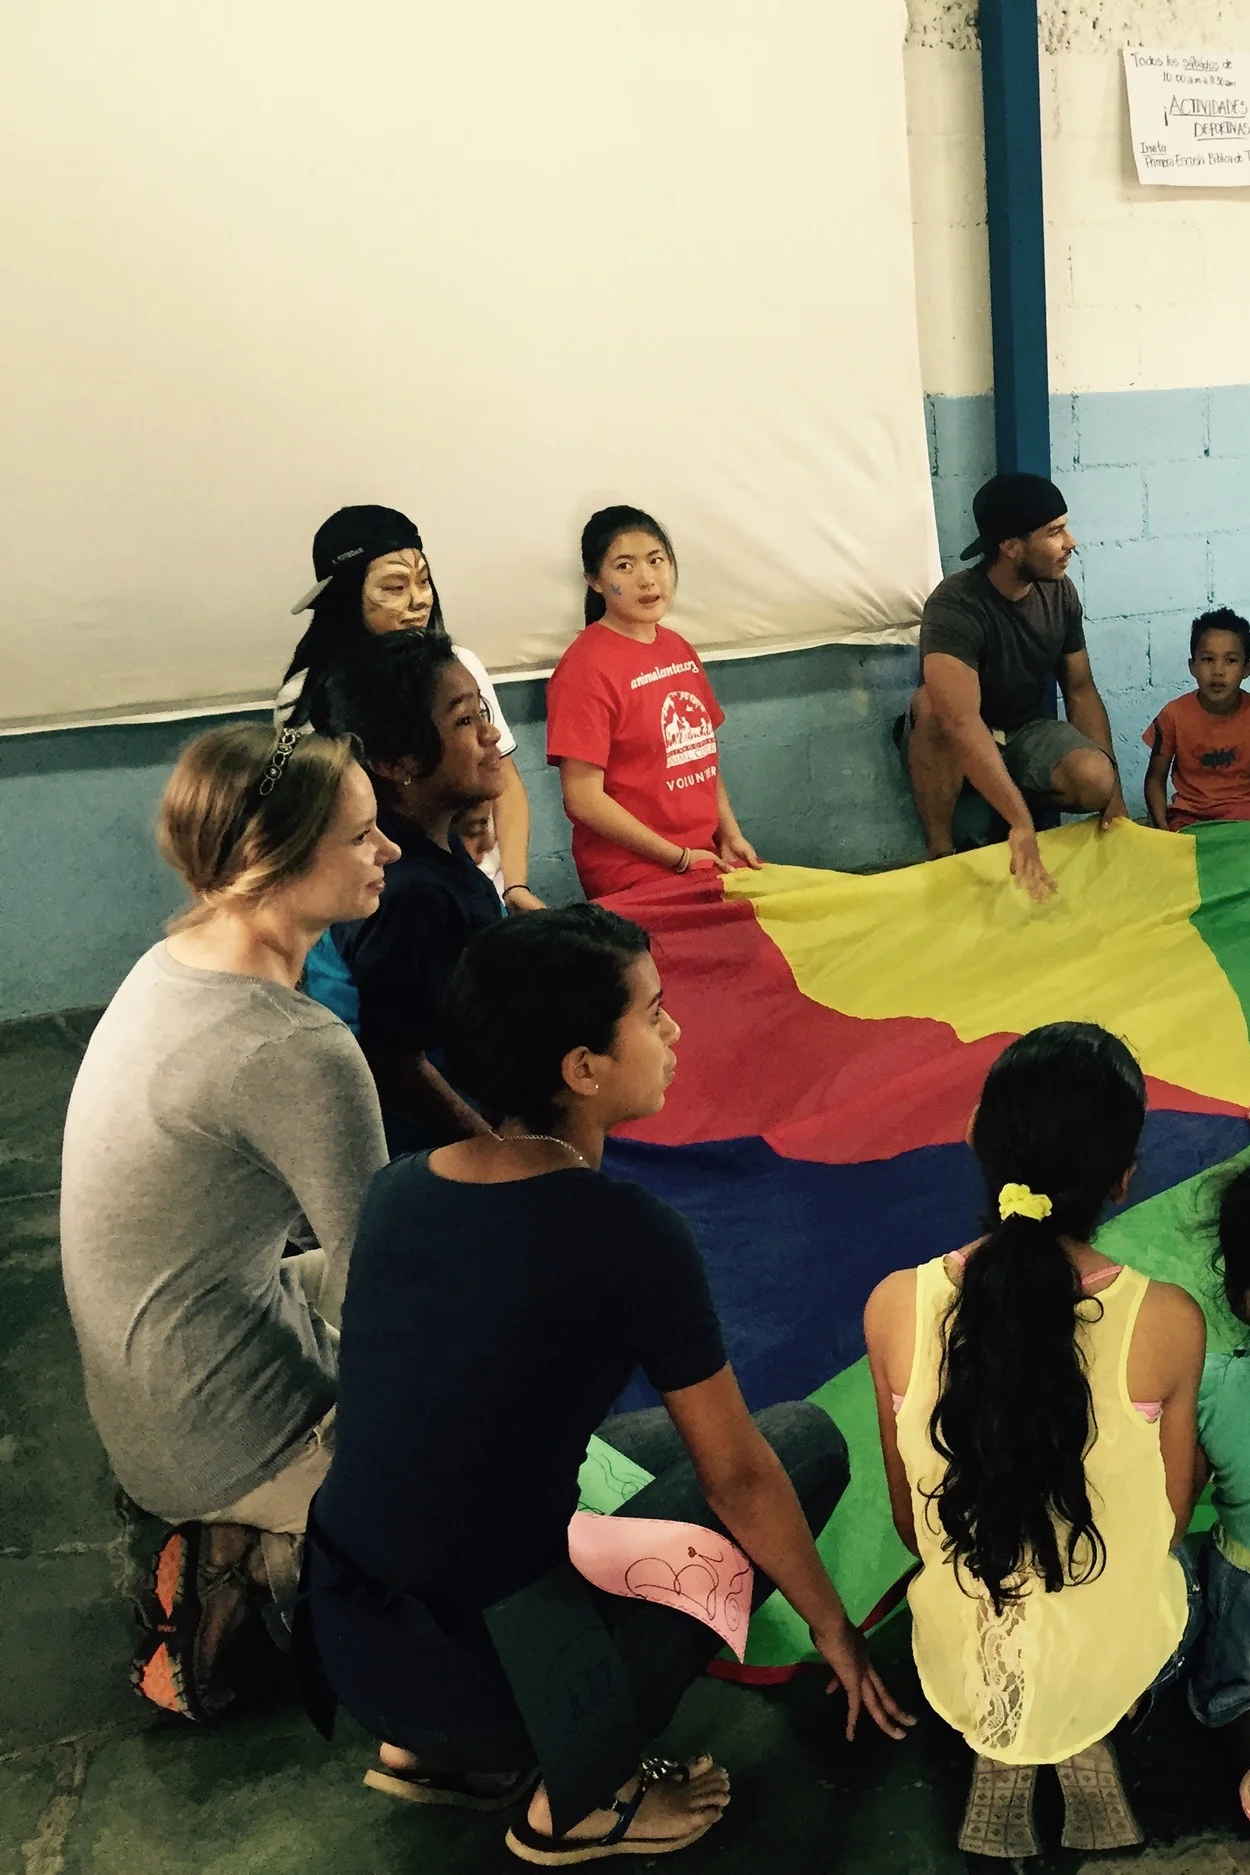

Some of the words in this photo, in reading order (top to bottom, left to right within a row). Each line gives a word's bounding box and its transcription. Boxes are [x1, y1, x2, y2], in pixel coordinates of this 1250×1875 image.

[1131, 52, 1164, 68] Todos
[1167, 55, 1179, 68] los
[1222, 58, 1233, 69] de
